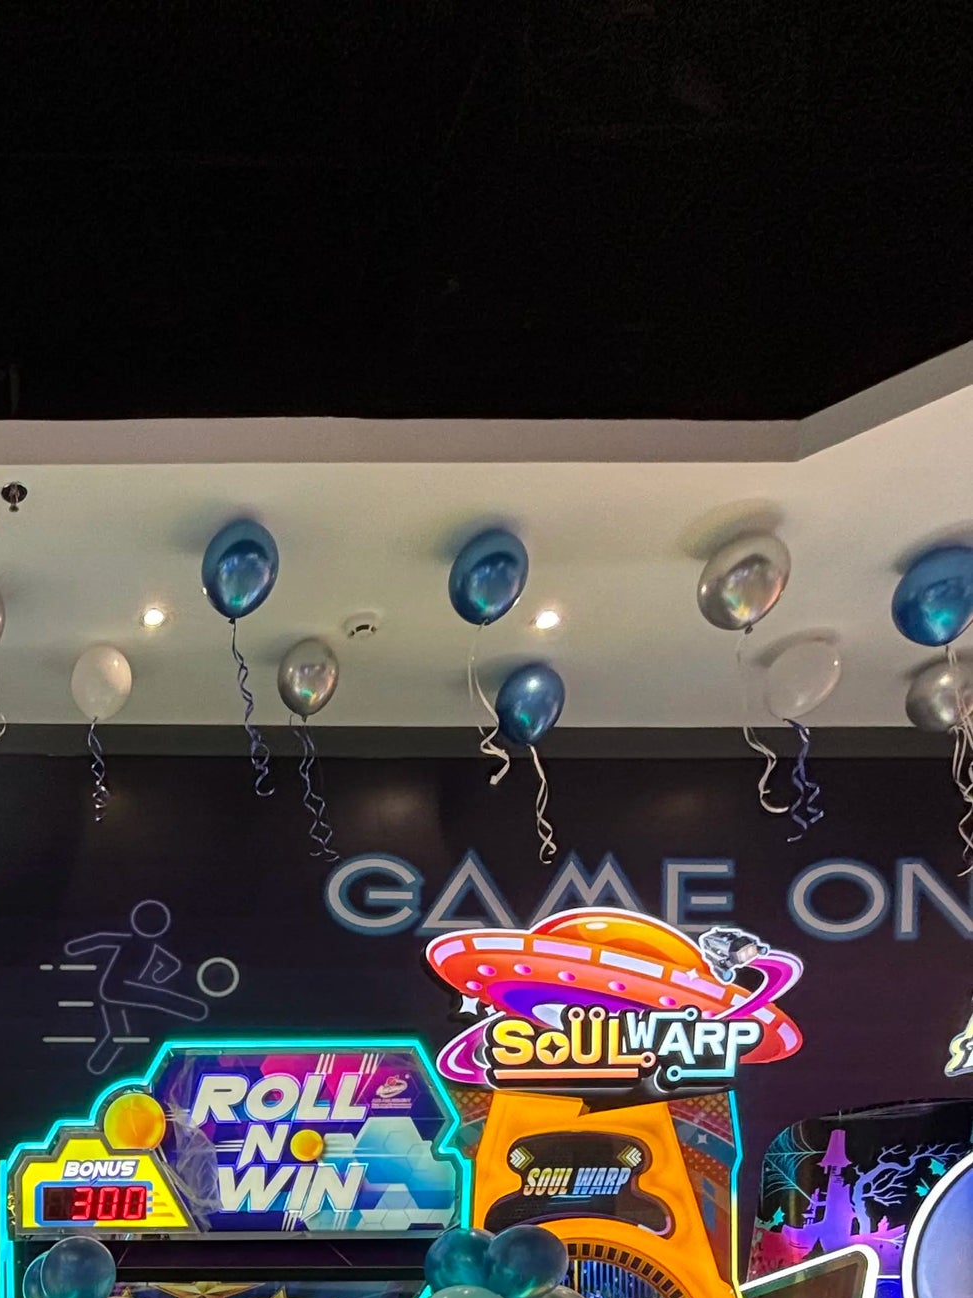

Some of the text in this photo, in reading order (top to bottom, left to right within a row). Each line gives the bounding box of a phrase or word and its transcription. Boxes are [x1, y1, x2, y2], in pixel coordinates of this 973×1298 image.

[327, 858, 729, 930] GAME
[626, 1007, 761, 1078] WARP
[191, 1074, 368, 1128] ROLL
[64, 1160, 136, 1180] BONUS
[237, 1122, 290, 1171] N
[72, 1186, 146, 1220] 300
[218, 1165, 367, 1221] WIN
[523, 1167, 631, 1196] SOUL WARP
